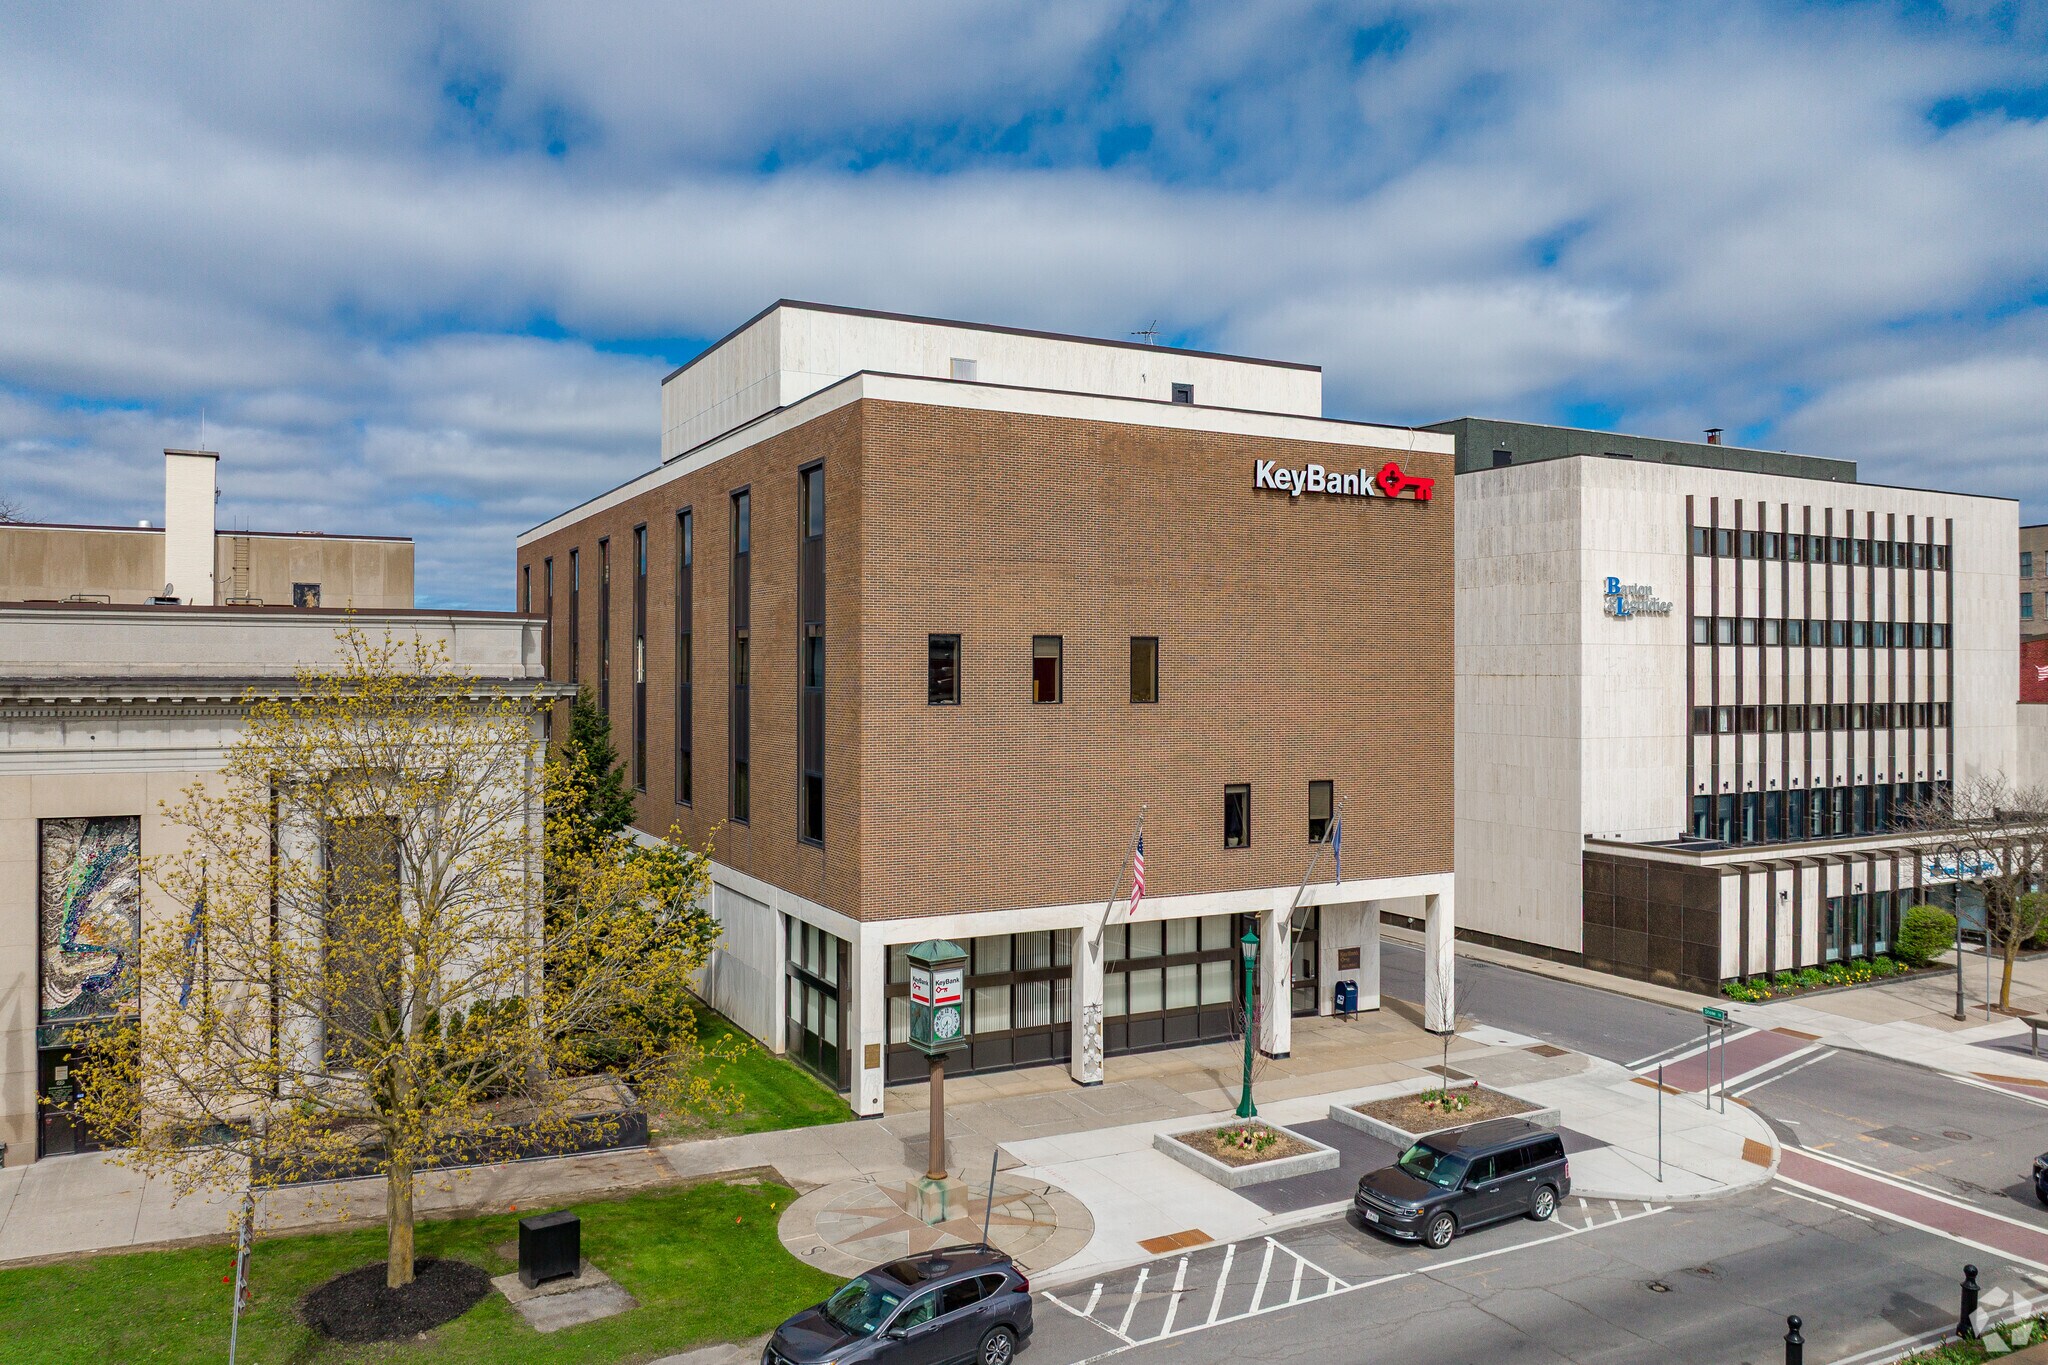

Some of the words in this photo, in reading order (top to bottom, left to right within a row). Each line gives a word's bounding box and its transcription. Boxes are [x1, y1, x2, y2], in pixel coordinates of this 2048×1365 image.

[1255, 459, 1375, 497] KeyBank
[1606, 576, 1653, 596] Barton
[912, 976, 929, 986] KeyBank
[936, 977, 960, 986] KeyBank
